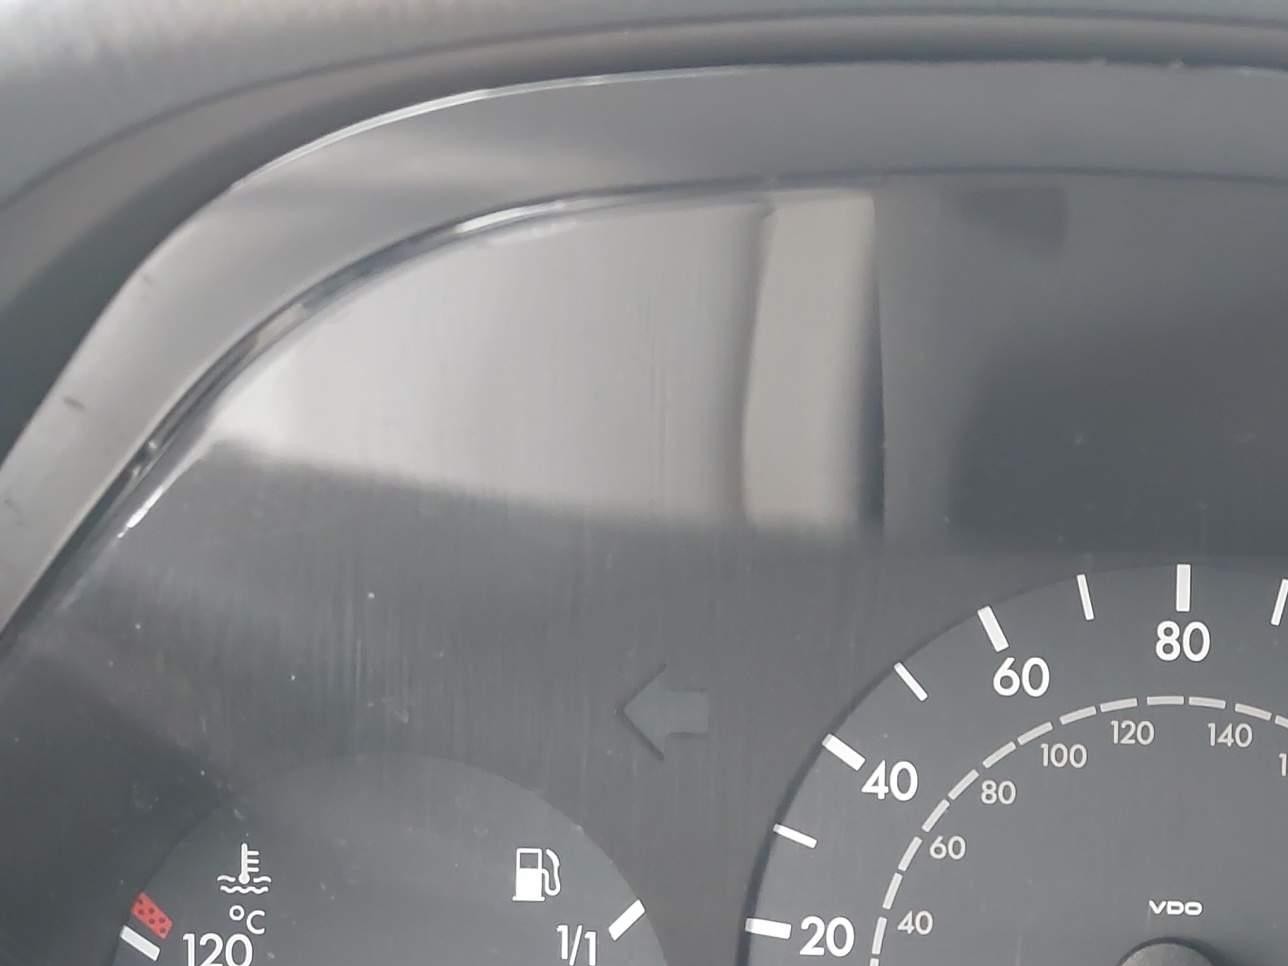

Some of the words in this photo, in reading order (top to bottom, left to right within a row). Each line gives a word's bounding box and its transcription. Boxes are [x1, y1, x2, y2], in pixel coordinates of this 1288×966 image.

[1155, 621, 1211, 662] 80
[993, 657, 1050, 697] 60
[1110, 720, 1155, 746] 120
[1207, 722, 1253, 748] 140
[1040, 743, 1088, 769] 100
[861, 760, 918, 802] 40
[980, 780, 1017, 805] 80
[929, 836, 966, 860] 60
[1149, 900, 1203, 916] VDO
[897, 910, 933, 936] 40
[556, 924, 598, 966] 1/1
[799, 916, 855, 957] 20
